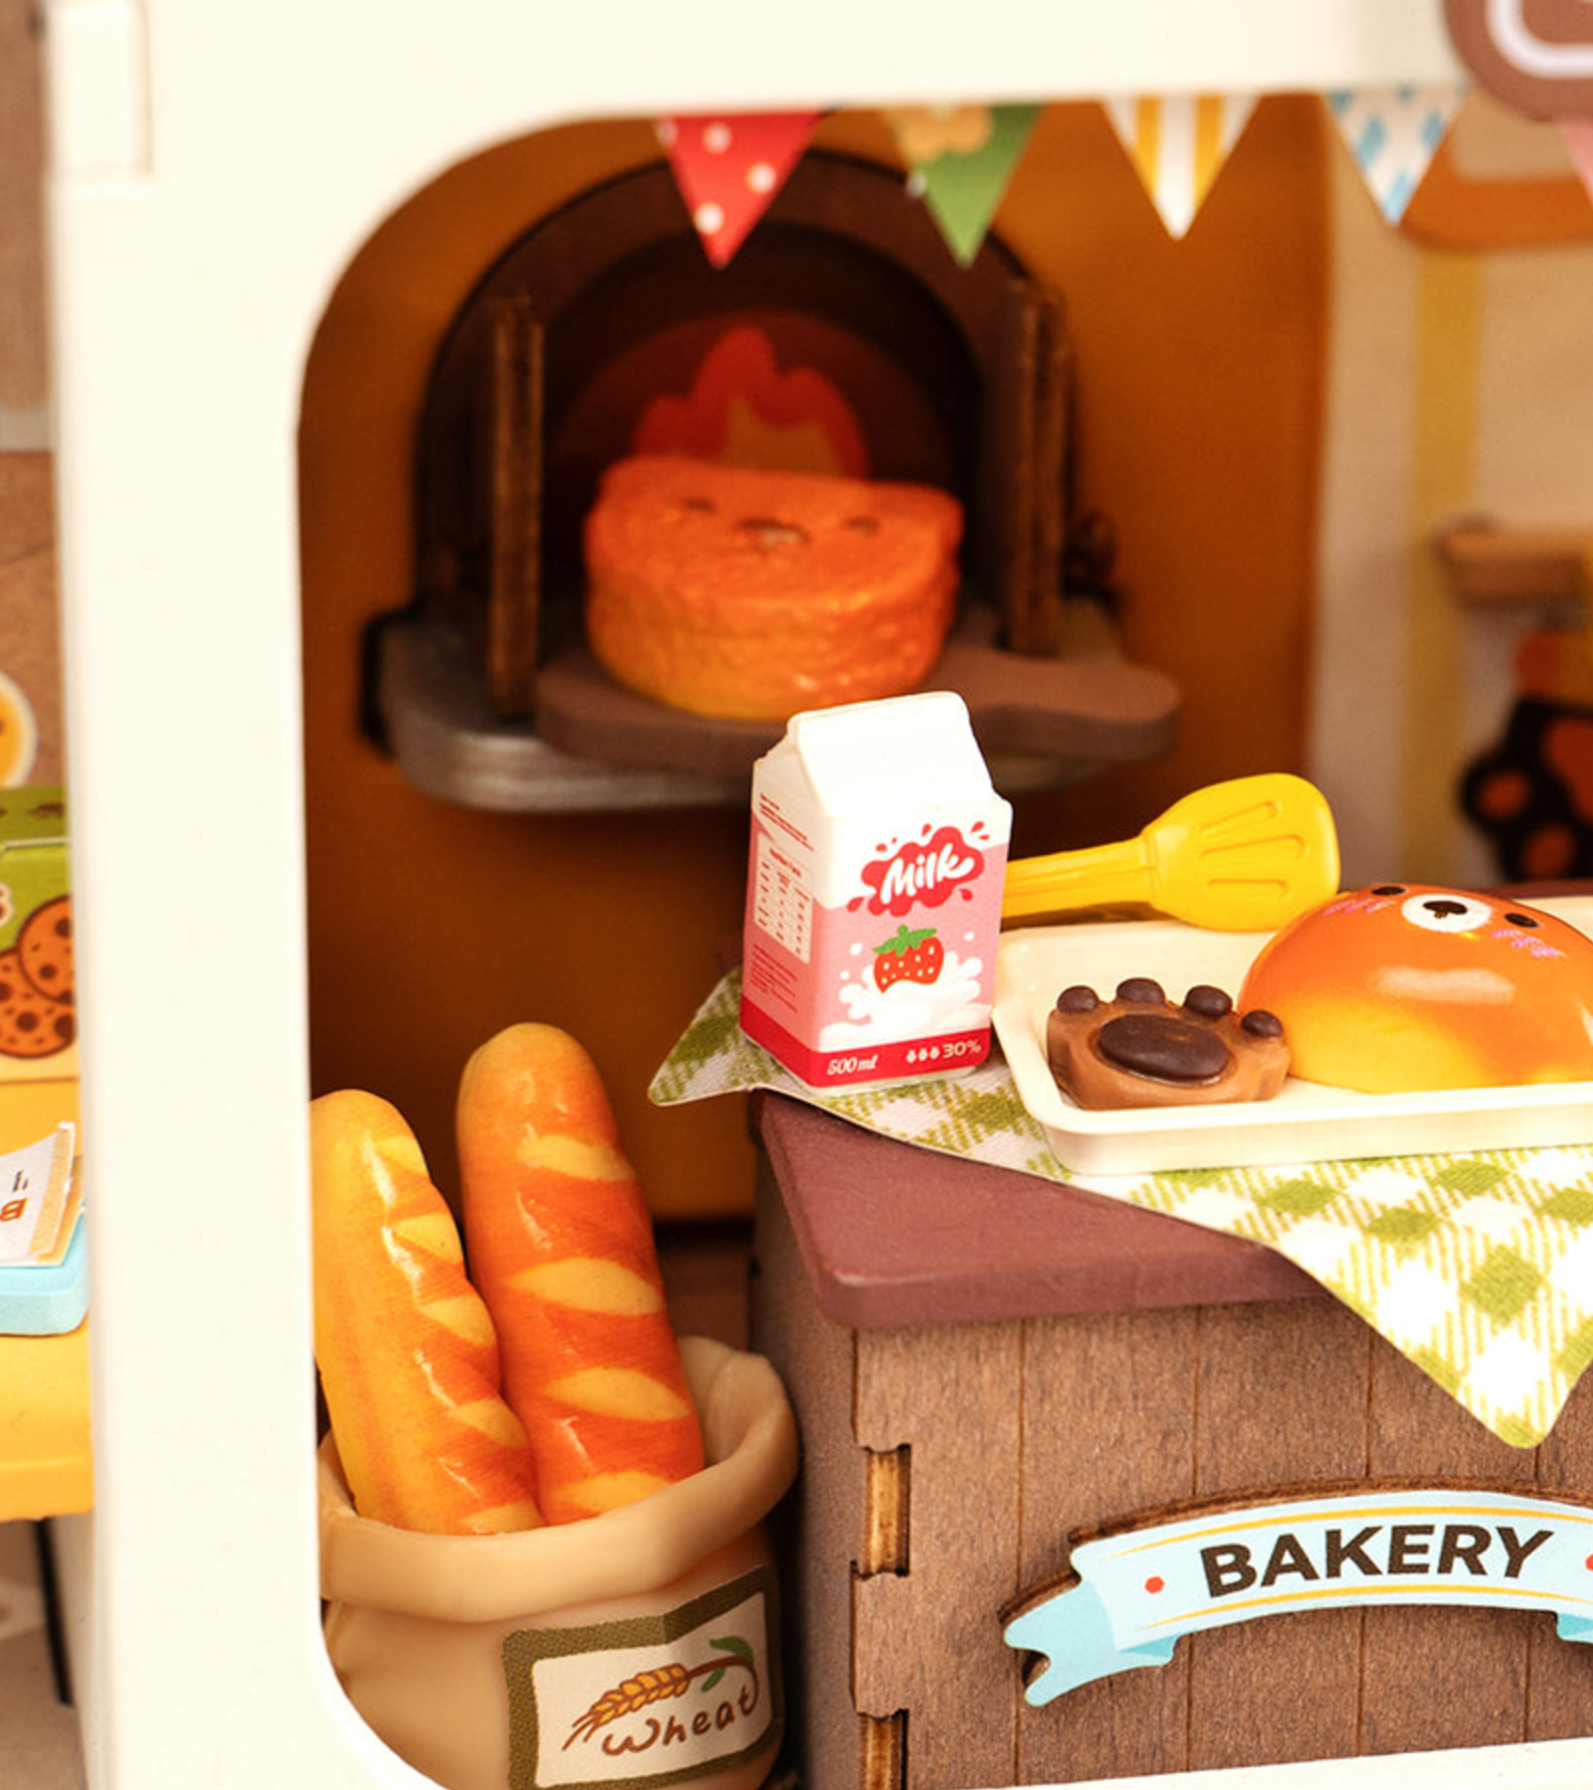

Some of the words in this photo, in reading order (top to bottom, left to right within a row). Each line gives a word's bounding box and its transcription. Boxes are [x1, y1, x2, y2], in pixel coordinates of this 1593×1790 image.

[880, 842, 975, 905] Milk
[942, 1038, 982, 1060] 30%
[1200, 1523, 1556, 1599] BAKERY
